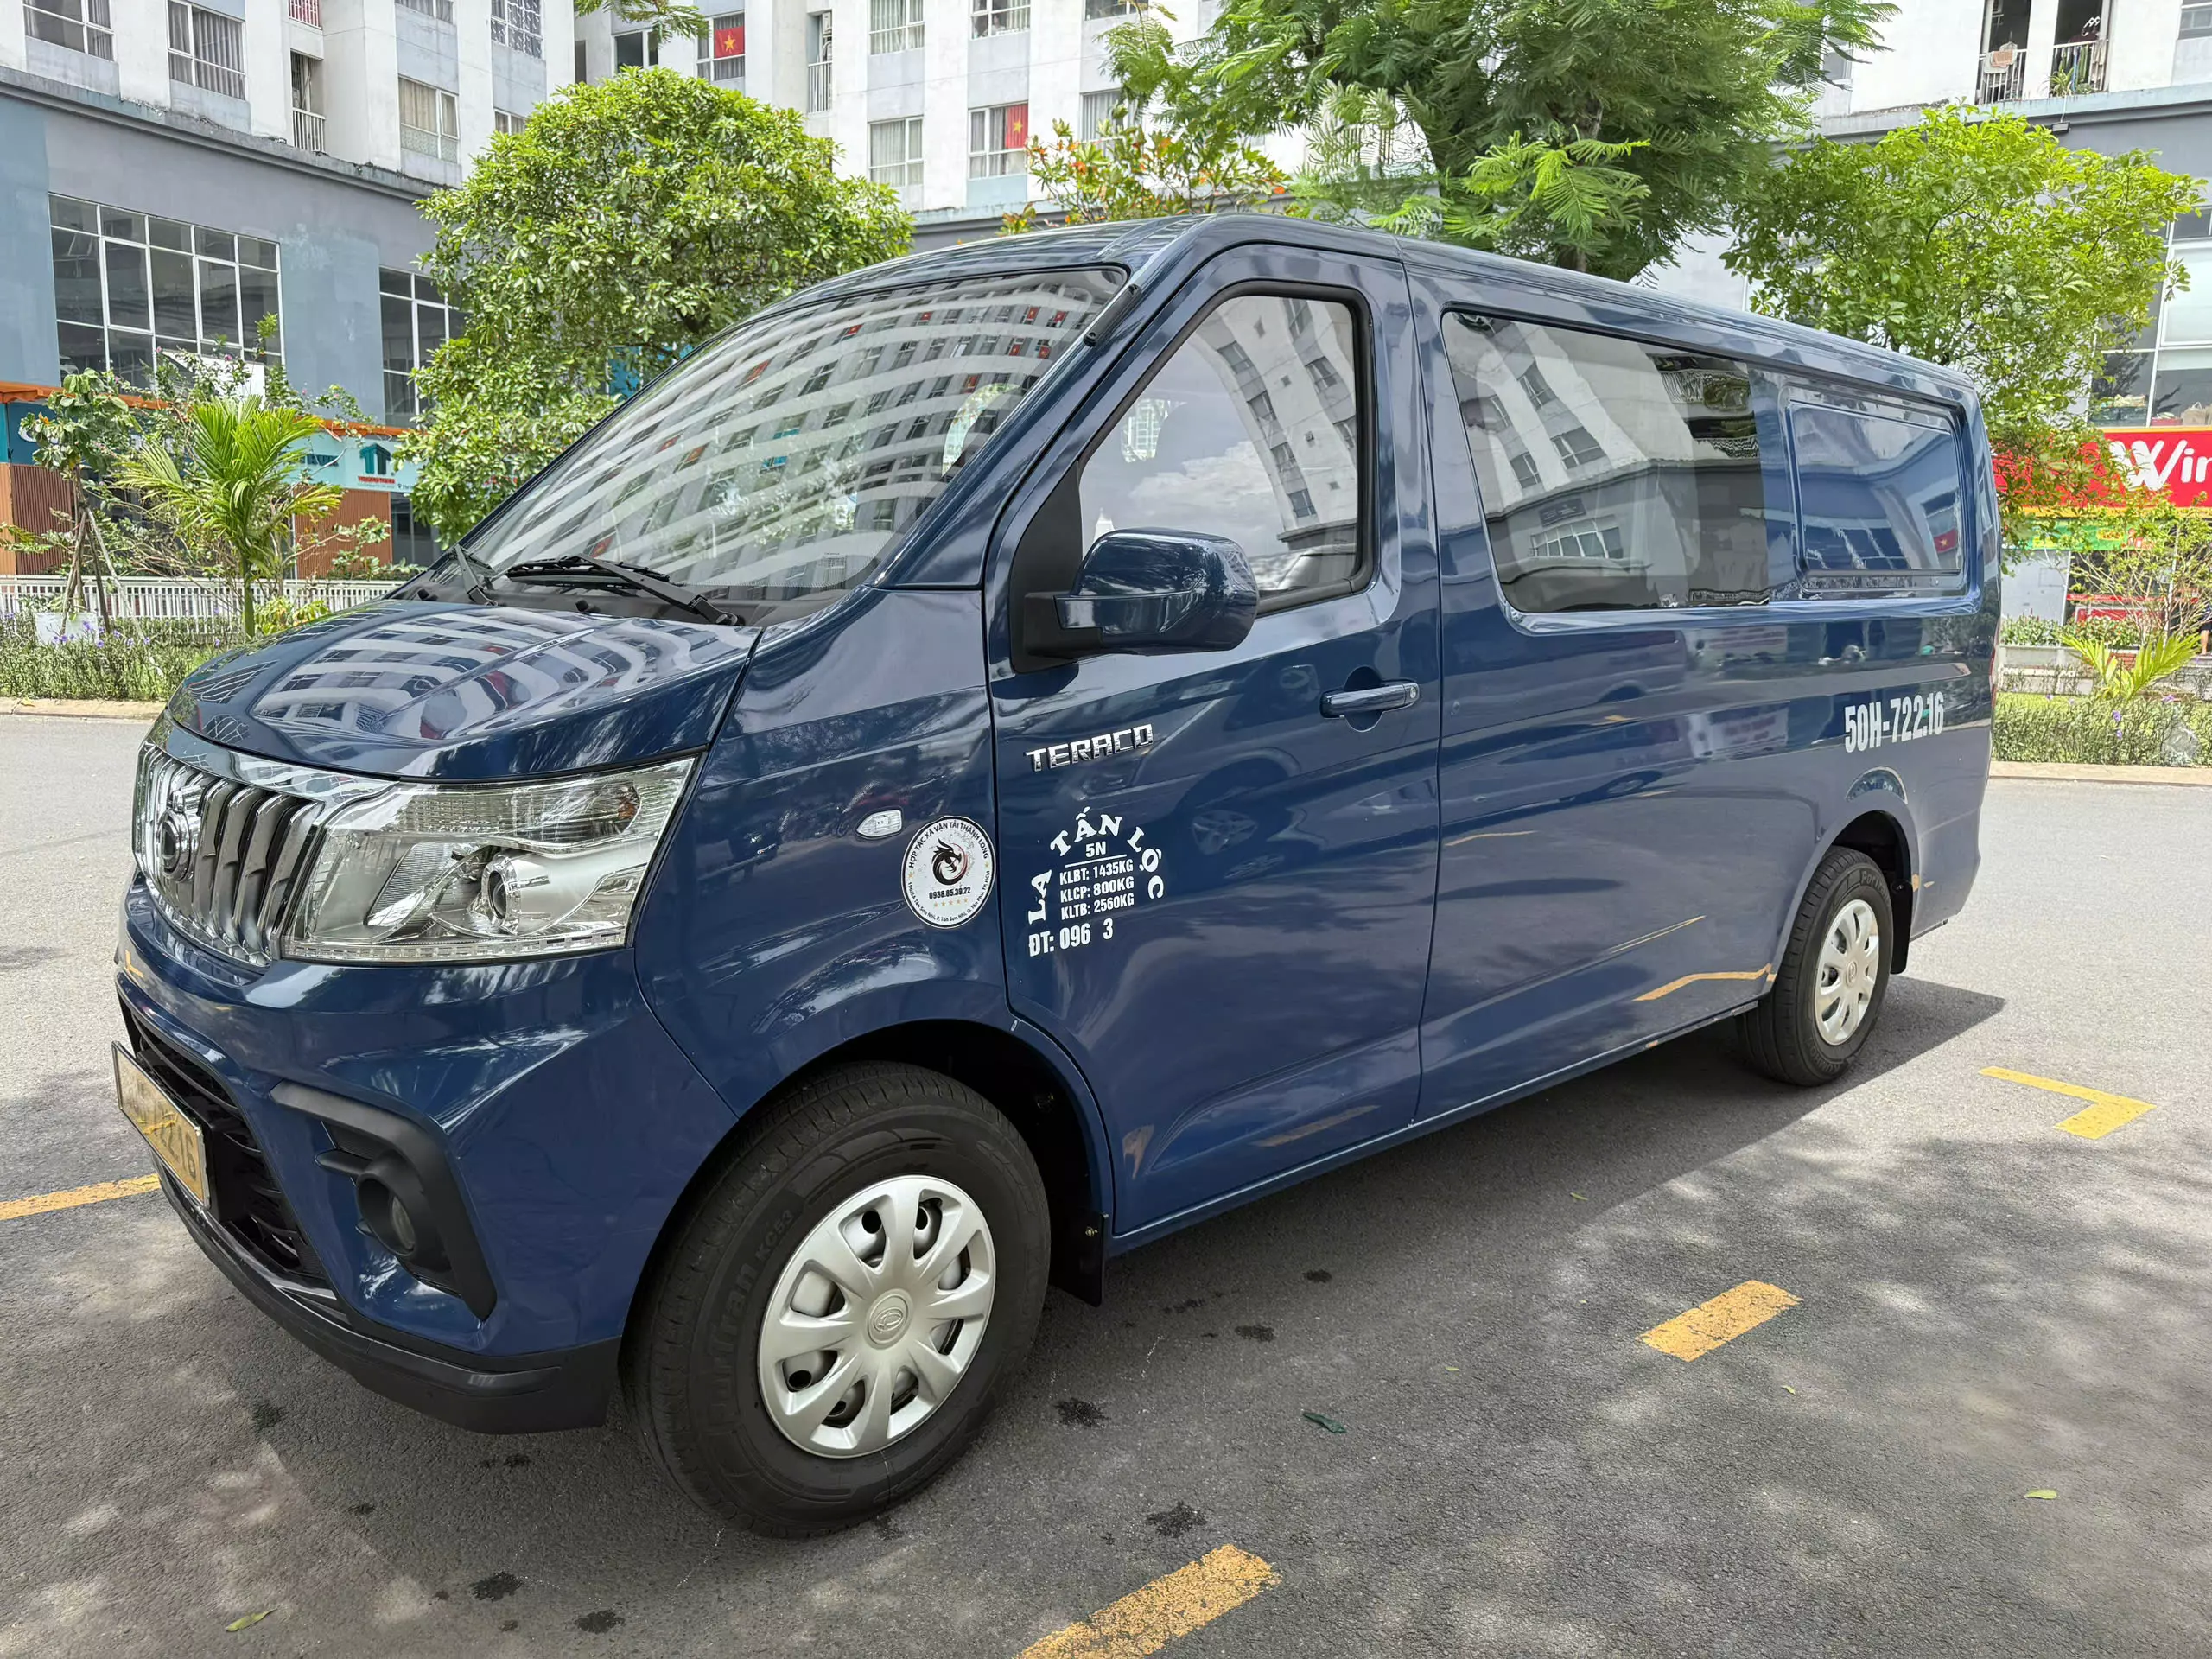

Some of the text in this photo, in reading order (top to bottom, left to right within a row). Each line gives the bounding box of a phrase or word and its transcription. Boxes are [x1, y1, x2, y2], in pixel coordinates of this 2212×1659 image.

[1844, 691, 1944, 753] 50H-722.16
[1023, 723, 1154, 772] TERACO
[978, 838, 989, 859] LONG
[1085, 841, 1107, 858] 5N
[1027, 869, 1052, 925] LA
[1050, 806, 1123, 857] TẤN
[1059, 859, 1134, 886] KLBT: 1435KG
[1060, 875, 1135, 903] KLCP: 800KG
[1061, 893, 1135, 920] KLTB: 2560KG
[1028, 918, 1114, 957] ĐT: 096 3
